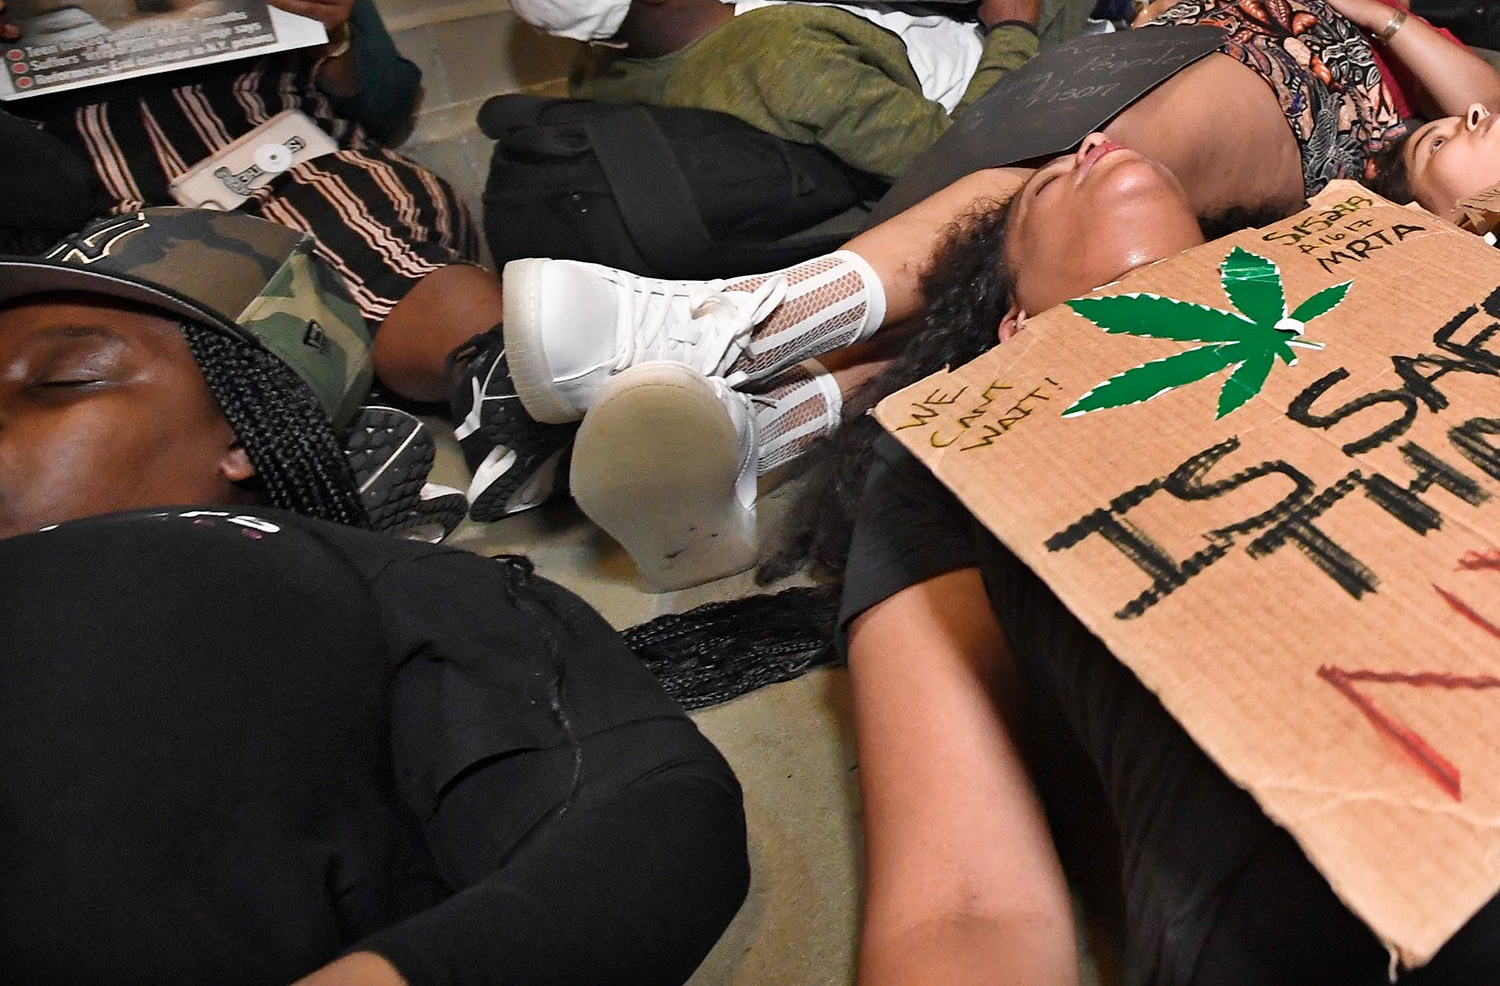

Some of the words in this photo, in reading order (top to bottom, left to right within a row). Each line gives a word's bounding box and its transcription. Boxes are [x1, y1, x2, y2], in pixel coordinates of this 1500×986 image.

[1316, 224, 1427, 274] MRTA
[893, 385, 969, 432] WE
[959, 377, 1064, 452] WAIT!
[1044, 434, 1316, 621] IS
